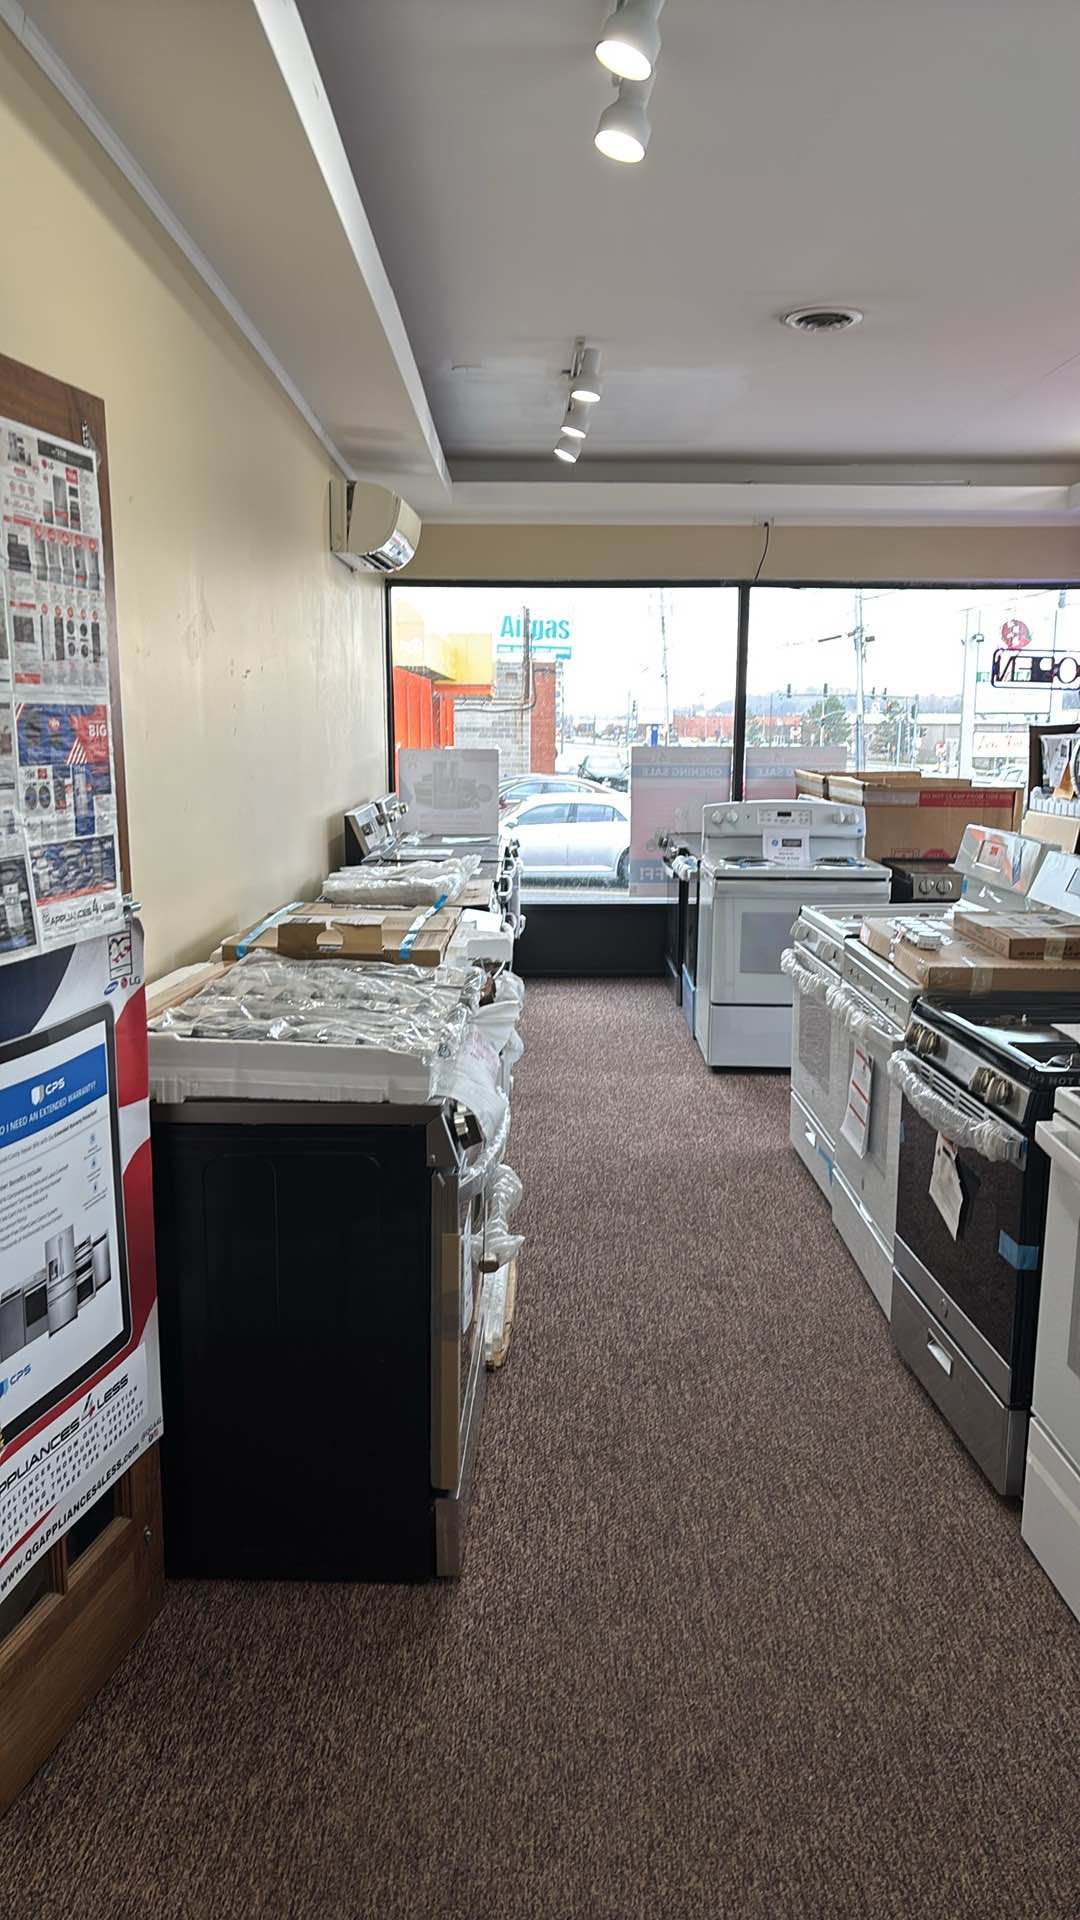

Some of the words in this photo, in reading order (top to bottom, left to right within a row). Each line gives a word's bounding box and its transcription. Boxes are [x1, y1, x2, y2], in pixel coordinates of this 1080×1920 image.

[500, 616, 570, 640] Aigas
[88, 724, 107, 737] BIG
[129, 976, 141, 986] LG
[45, 1077, 65, 1096] CPS
[10, 1115, 28, 1131] NEED
[29, 1110, 39, 1123] AN
[40, 1096, 67, 1118] EXTENDED
[10, 1364, 32, 1386] CPS
[81, 1393, 96, 1421] 4
[97, 1373, 128, 1410] LESS
[0, 1463, 51, 1517] PPLIANCES
[56, 1440, 79, 1462] FROM
[82, 1421, 98, 1440] OUR
[101, 1385, 138, 1422] LOCATION
[2, 1505, 17, 1525] NOT
[22, 1481, 45, 1504] ONLY
[50, 1424, 105, 1479] THOROUGHLY
[109, 1396, 135, 1425] TESTED
[8, 1490, 46, 1532] LEAVING
[51, 1471, 67, 1489] THE
[104, 1420, 122, 1440] THEY
[126, 1399, 144, 1419] EACH
[0, 1527, 19, 1554] WITH
[33, 1493, 55, 1517] YEAR
[60, 1469, 81, 1493] FREE
[0, 1442, 140, 1592] www.QGAPPLIANCES4LESS.com
